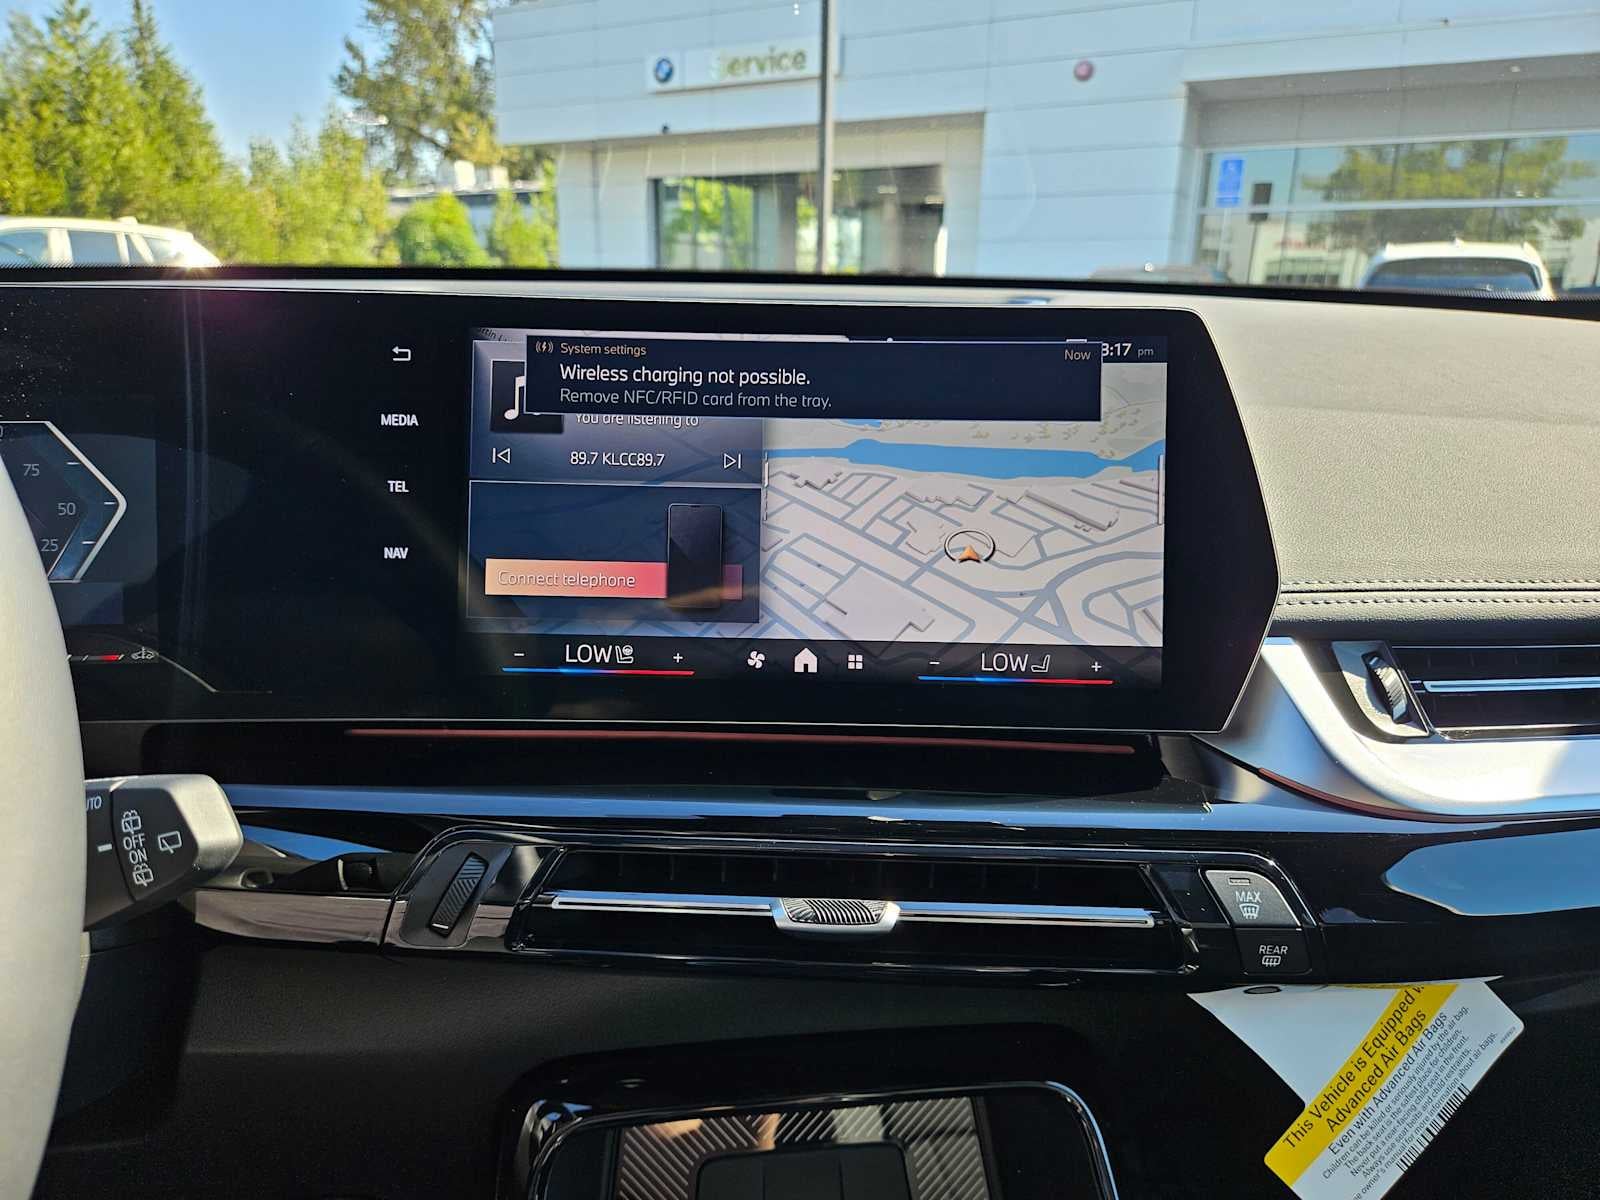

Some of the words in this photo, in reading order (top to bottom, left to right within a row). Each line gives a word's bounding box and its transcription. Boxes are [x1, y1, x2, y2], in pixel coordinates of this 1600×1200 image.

[712, 46, 807, 79] ervice
[560, 342, 601, 355] System
[604, 345, 647, 357] settings
[1064, 348, 1091, 361] Now
[1137, 348, 1154, 358] pm
[560, 363, 628, 381] Wireless
[632, 366, 703, 387] charging
[708, 369, 735, 384] not
[739, 368, 811, 387] possible.
[560, 388, 619, 404] Remove
[623, 390, 699, 405] NFC/RFID
[702, 392, 733, 406] card
[738, 392, 770, 407] from
[774, 393, 798, 408] the
[801, 394, 832, 410] tray.
[380, 413, 419, 427] MEDIA
[576, 414, 599, 424] You
[602, 414, 624, 425] are
[627, 415, 682, 428] listening
[686, 416, 699, 426] to
[570, 451, 599, 465] 89.7
[602, 452, 665, 467] KLCC89.7
[23, 463, 41, 477] 75
[387, 480, 409, 493] TEL
[57, 502, 77, 516] 50
[40, 538, 60, 552] 25
[383, 547, 409, 559] NAV
[498, 570, 560, 586] Connect
[562, 573, 637, 588] telephone
[565, 644, 613, 663] LOW
[981, 652, 1030, 672] LOW
[86, 796, 102, 811] UTO
[123, 833, 147, 850] OFF
[129, 849, 149, 864] ON
[1235, 890, 1262, 903] MAX
[1258, 944, 1289, 955] REAR
[1283, 1116, 1313, 1148] This
[1309, 1068, 1355, 1119] Vehicle
[1351, 1054, 1366, 1071] is
[1361, 990, 1417, 1058] Equipped
[1324, 1064, 1383, 1131] Advanced
[1378, 1042, 1399, 1066] Air
[1394, 1009, 1427, 1045] Bags
[1328, 1126, 1354, 1154] Even
[1351, 1104, 1374, 1129] with
[1370, 1054, 1414, 1107] Advanced
[1410, 1037, 1426, 1056] Air
[1422, 1012, 1447, 1040] Bags
